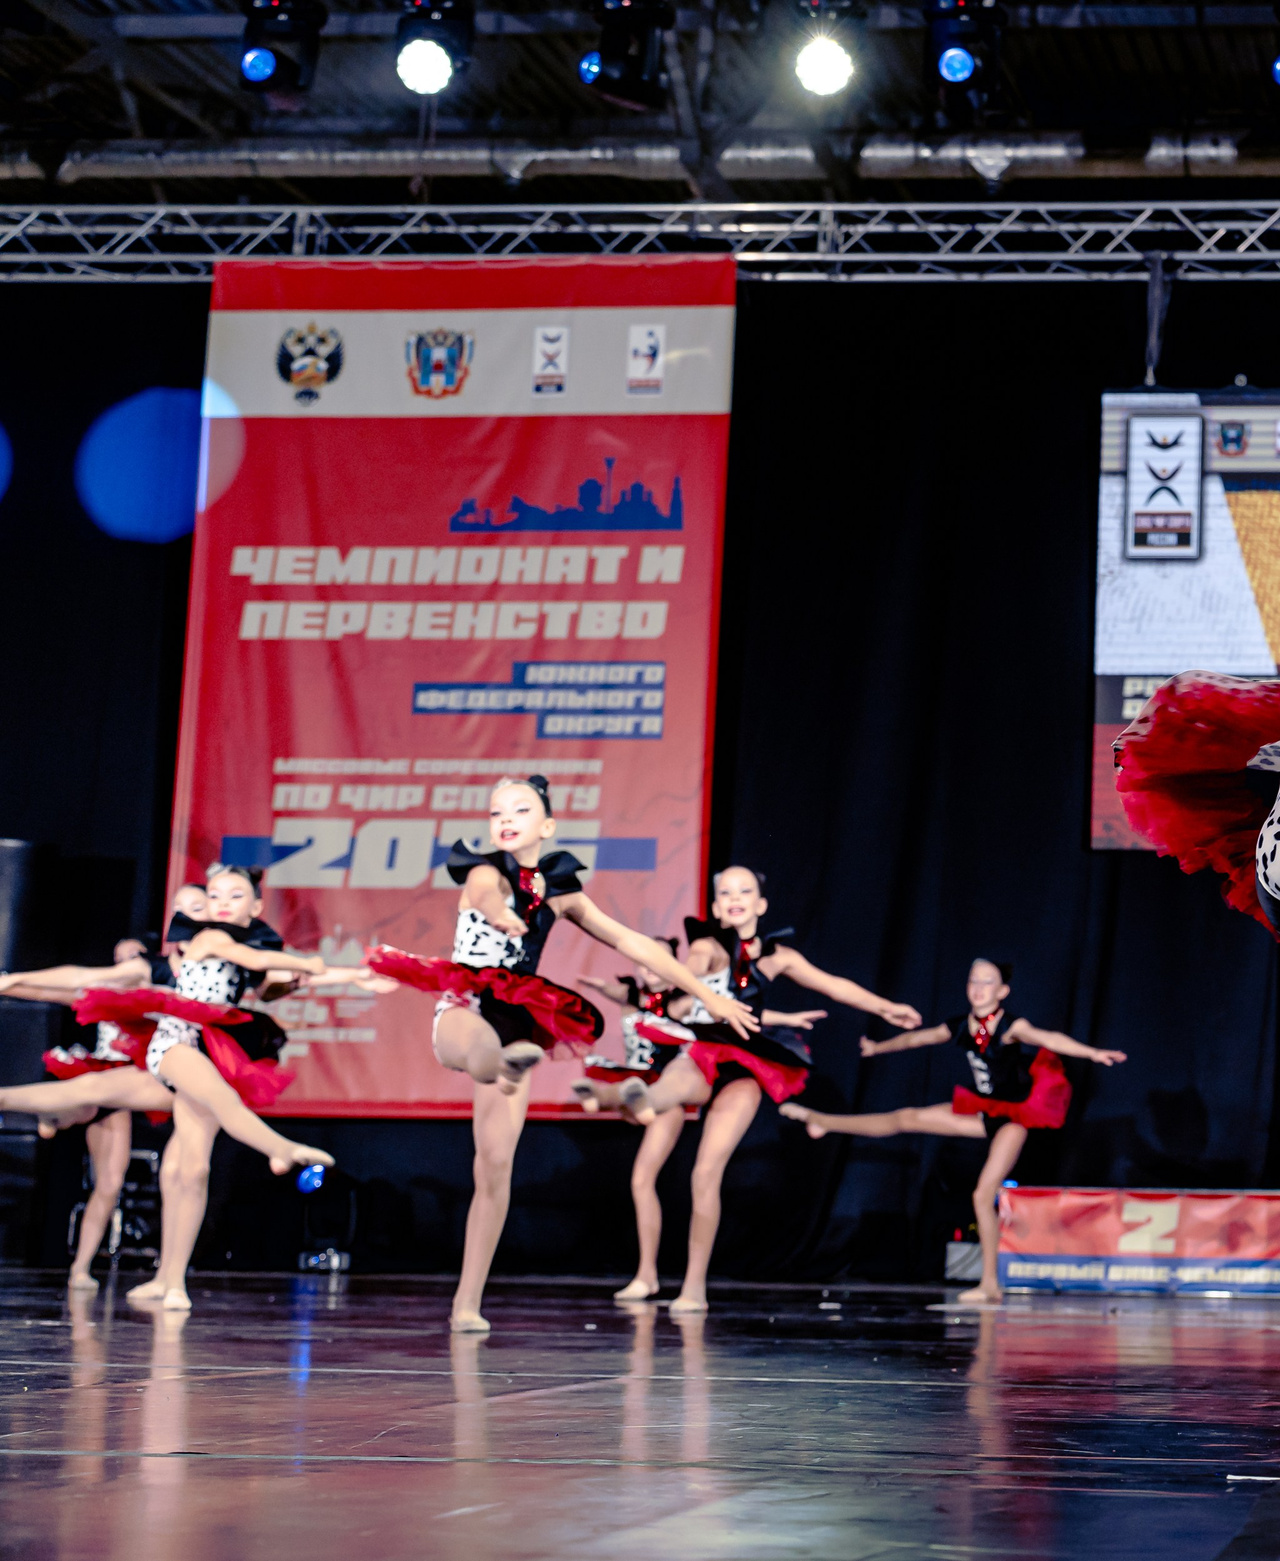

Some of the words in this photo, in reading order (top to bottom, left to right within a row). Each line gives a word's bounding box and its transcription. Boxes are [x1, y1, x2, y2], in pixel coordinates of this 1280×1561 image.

[231, 546, 629, 586] ЧЕМПИОНАТ
[637, 546, 685, 584] И
[239, 601, 669, 640] ПЕРВЕНСТВО
[525, 664, 665, 685] ЮЖНОГО
[415, 688, 664, 710] ФЕДЕРАЛЬНОГО
[543, 714, 663, 735] ОКРУГА
[272, 783, 333, 811] ПО
[338, 784, 426, 811] ЧИР
[431, 784, 602, 812] СПТУ
[1117, 1202, 1181, 1254] 2
[1007, 1261, 1105, 1280] ПЕРВЫЙ
